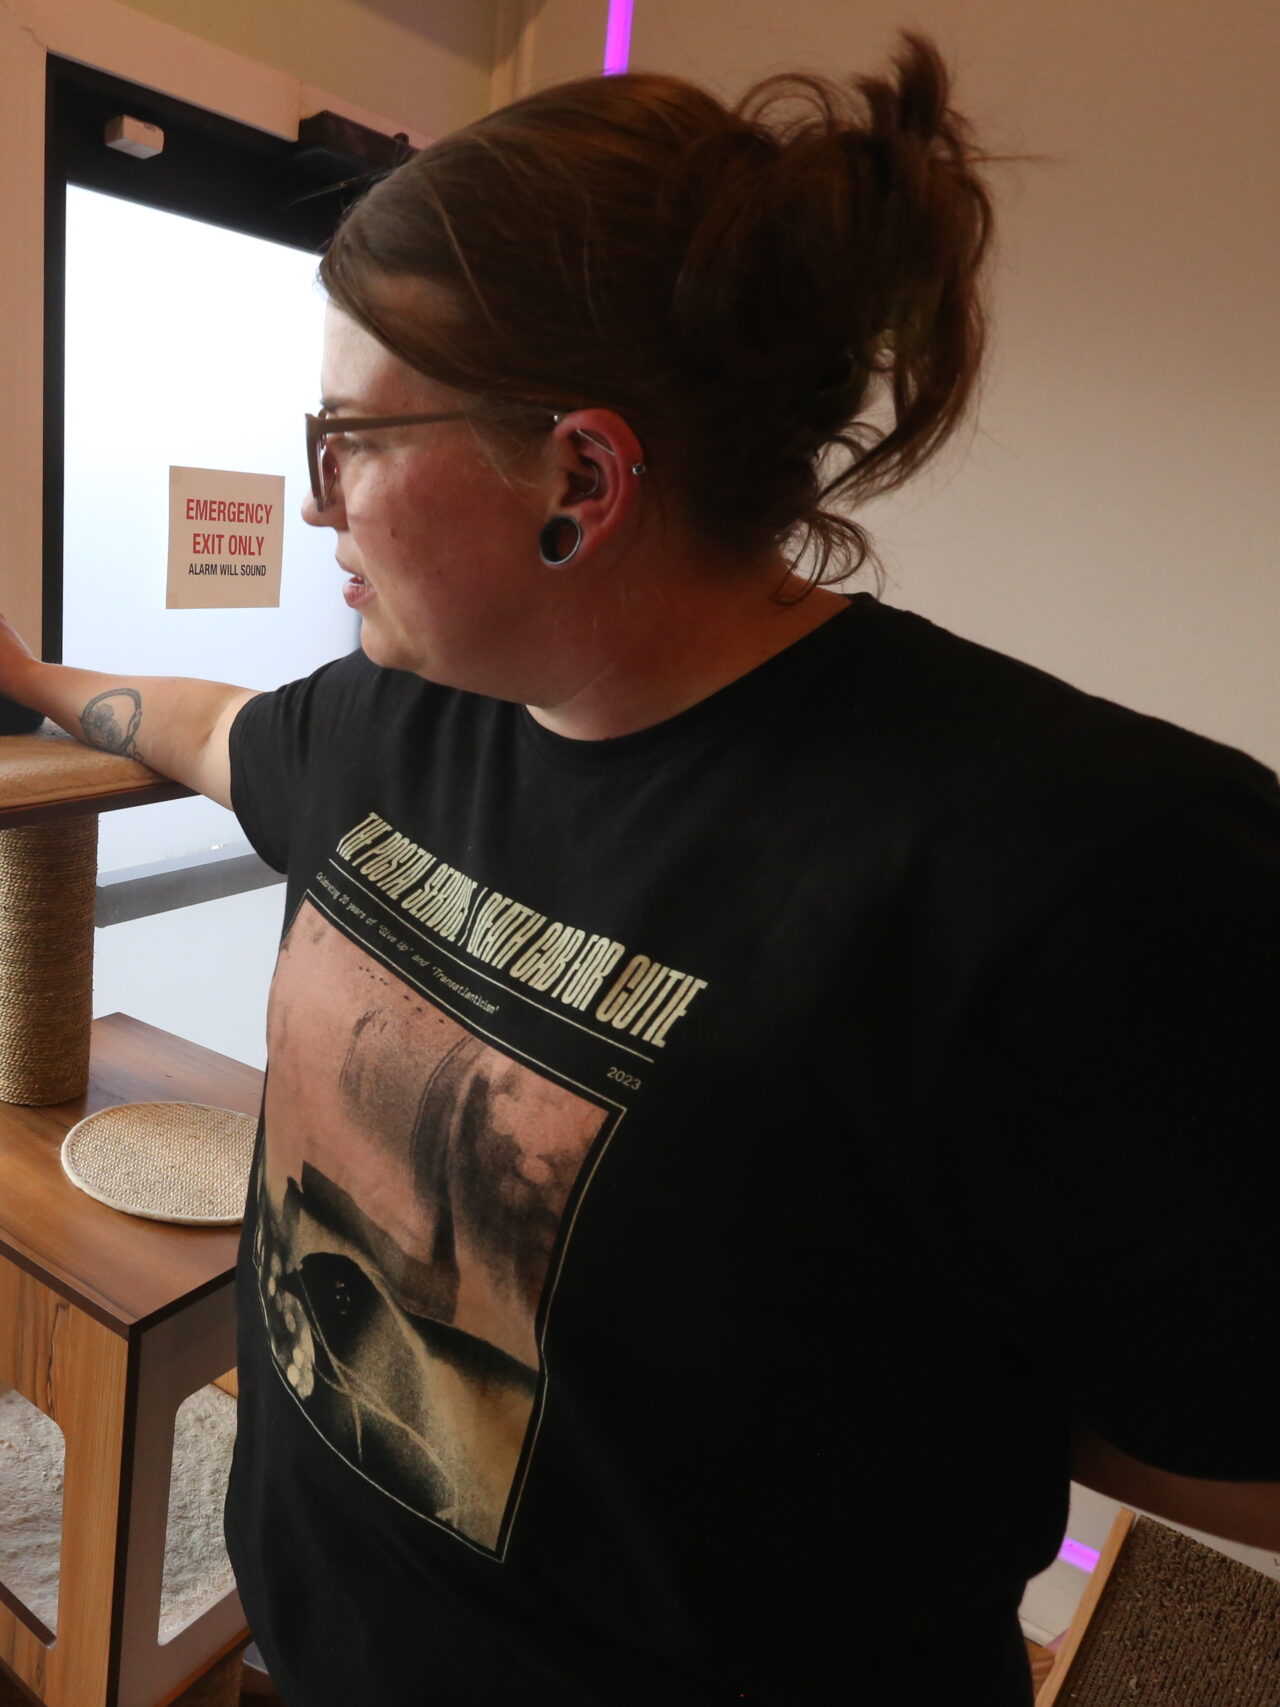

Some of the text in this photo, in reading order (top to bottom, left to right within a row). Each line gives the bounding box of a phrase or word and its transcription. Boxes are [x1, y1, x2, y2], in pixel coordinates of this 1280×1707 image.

[186, 498, 273, 525] EMERGENCY
[192, 533, 265, 556] EXIT ONLY
[188, 563, 267, 576] ALARM WILL SOUND
[336, 811, 393, 861] THE
[351, 831, 437, 900] POSTAL
[346, 902, 367, 919] years
[365, 917, 378, 926] of
[411, 953, 430, 967] and
[401, 862, 478, 943] SERVICE
[466, 892, 548, 969] DEATH
[509, 921, 586, 993] CAB
[551, 933, 626, 1012] FOR
[595, 954, 709, 1049] CUTIE
[606, 1066, 642, 1090] 2023
